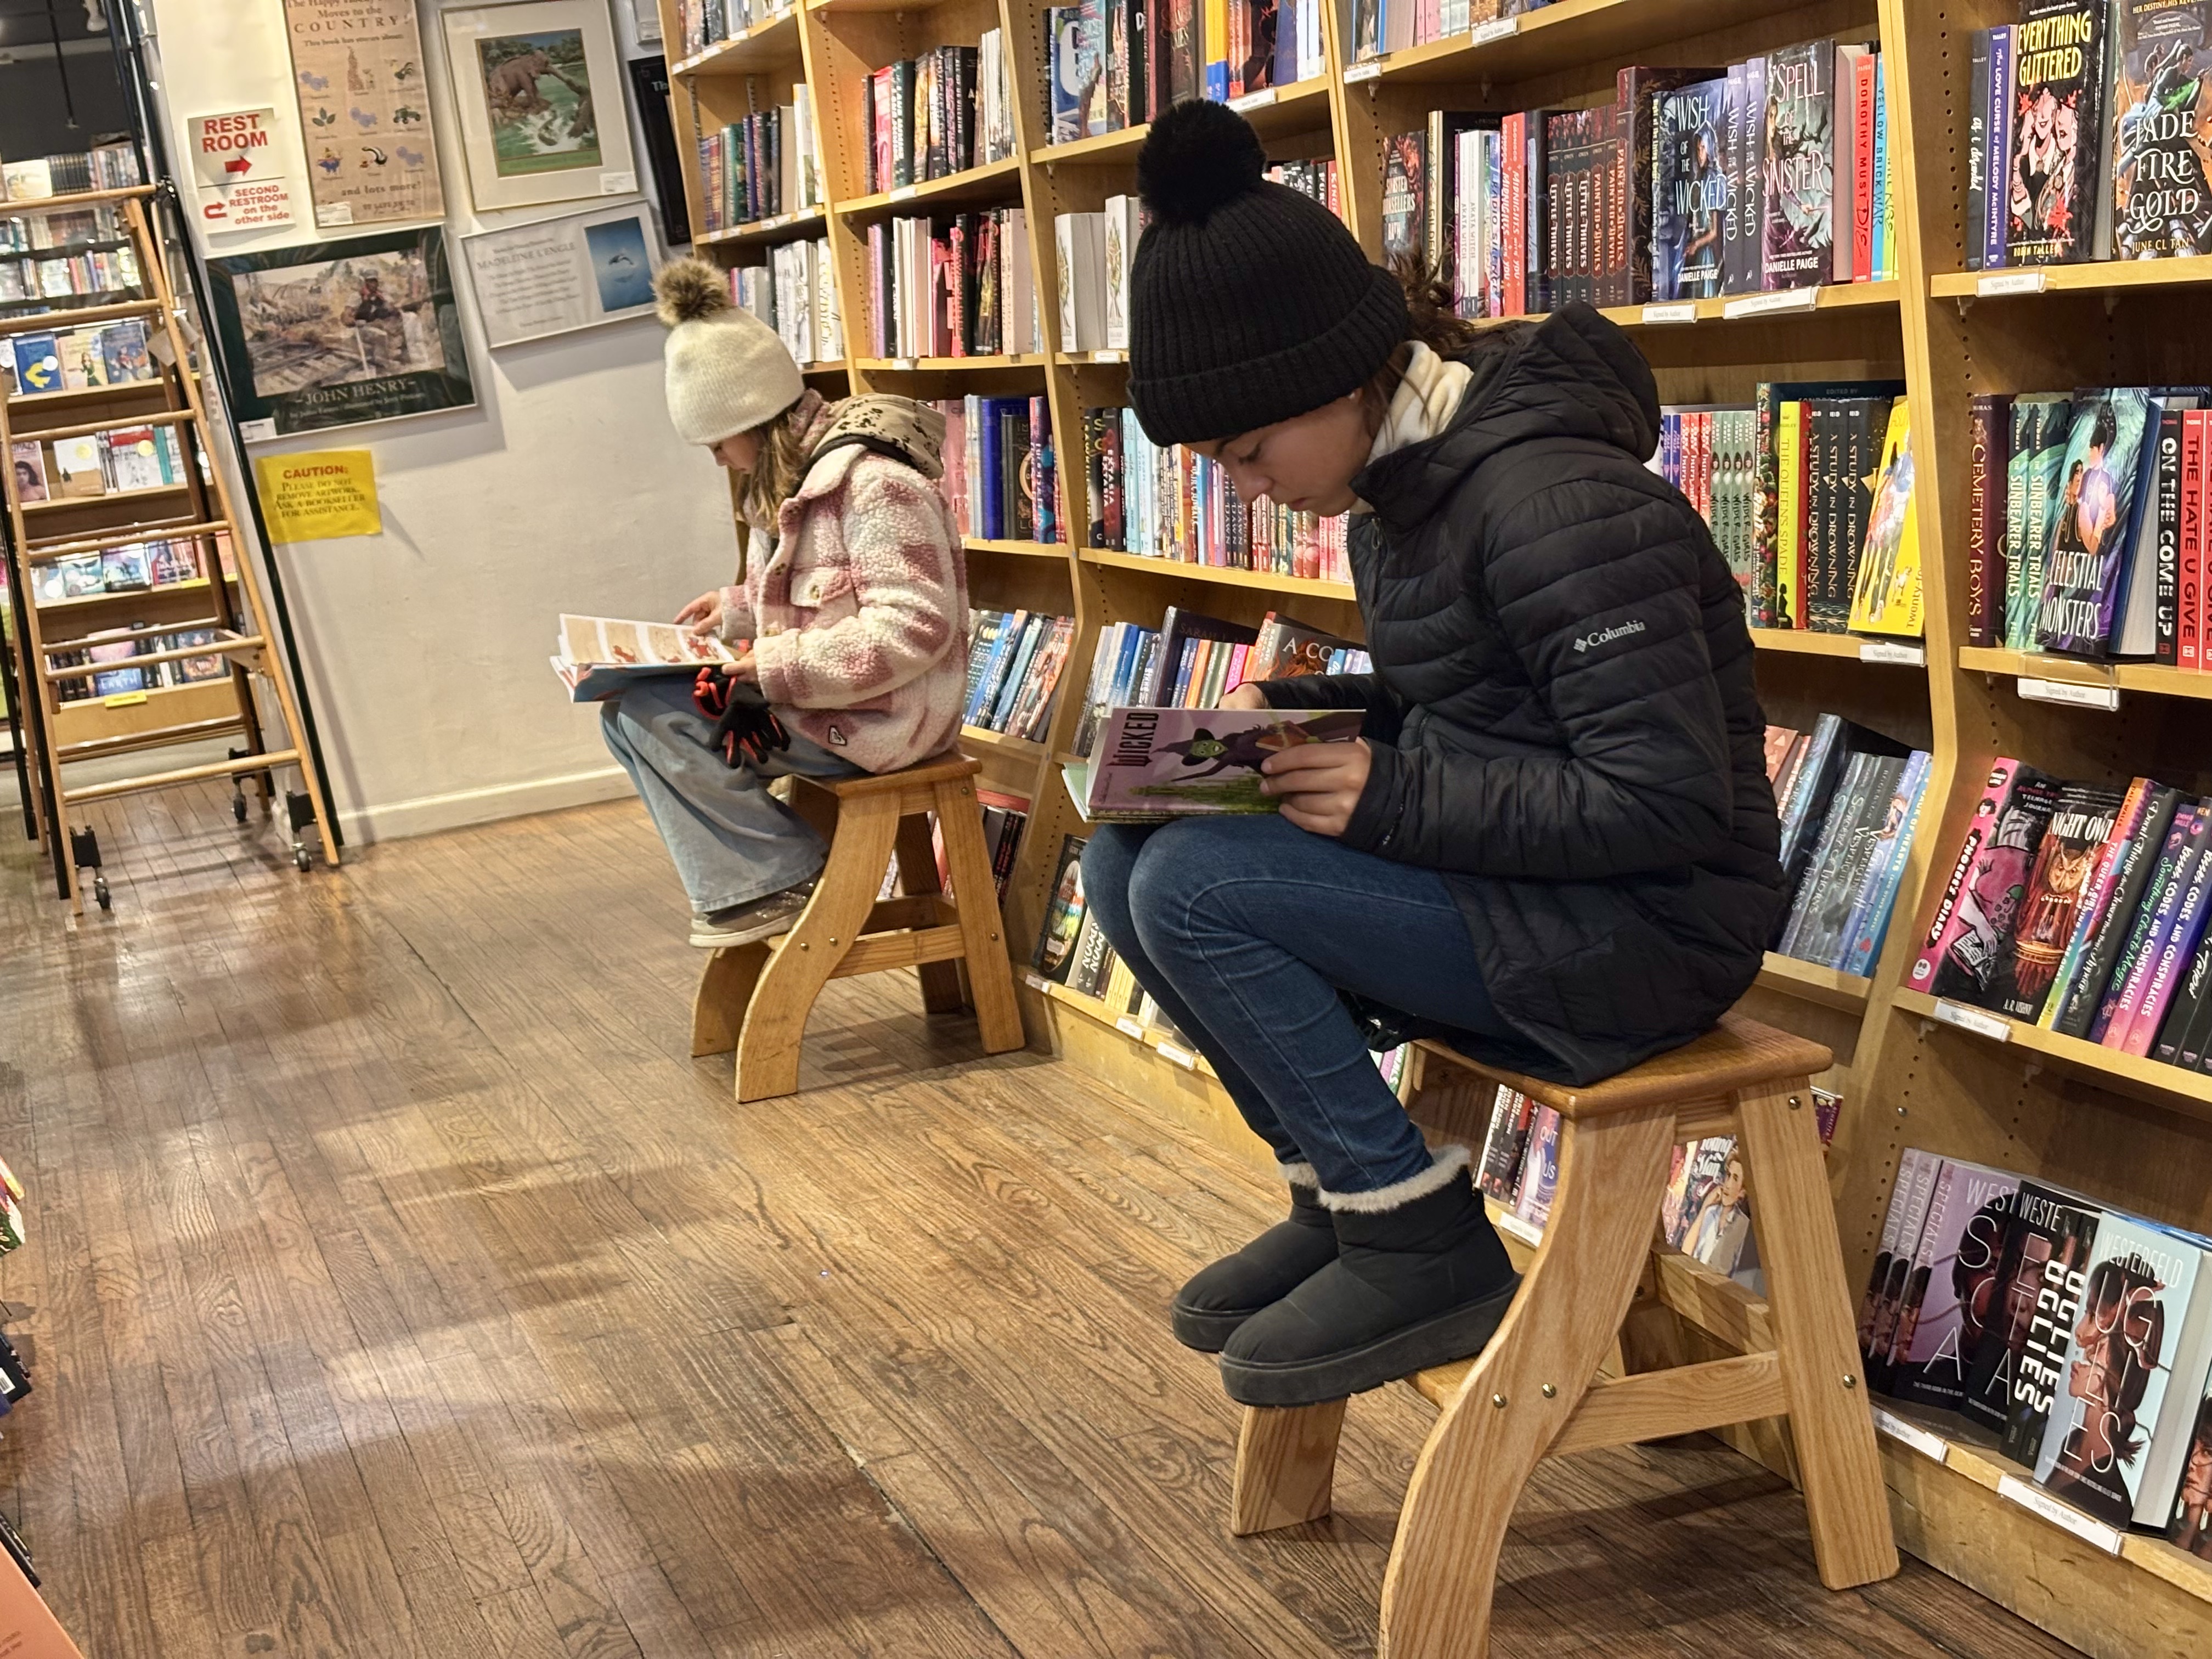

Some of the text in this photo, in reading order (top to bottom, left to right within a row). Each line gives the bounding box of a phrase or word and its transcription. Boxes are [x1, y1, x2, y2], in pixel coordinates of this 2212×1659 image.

[2133, 6, 2142, 14] HER
[2017, 10, 2092, 55] EVERYTHING
[1776, 60, 1825, 103] SPELL
[2019, 47, 2083, 87] GLITTERED
[204, 114, 259, 134] REST
[1677, 94, 1711, 132] WISH
[1785, 110, 1794, 126] OF
[1877, 88, 1886, 140] YELLOW
[2131, 110, 2198, 152] JADE
[202, 131, 268, 153] ROOM
[1680, 140, 1688, 155] OF
[1783, 133, 1795, 146] THE
[1858, 78, 1868, 201] DOROTHY MUST
[1681, 158, 1690, 173] THE
[1725, 107, 1740, 241] WISH WICKED
[1745, 101, 1757, 236] WISH WICKED
[1762, 149, 1832, 198] SINISTER
[2134, 148, 2195, 184] FIRE
[229, 193, 289, 207] RESTROOM
[235, 185, 279, 197] SECOND
[244, 206, 257, 215] on
[341, 187, 360, 196] and
[365, 185, 386, 194] lots
[1512, 171, 1520, 235] MIDNIGHTS
[1550, 184, 1558, 221] LITTLE
[1675, 173, 1726, 218] WICKED
[1873, 192, 1884, 228] WAR
[2127, 188, 2199, 234] GOLD
[235, 211, 289, 224] other side
[1565, 182, 1573, 269] LITTLE THIEVES
[1578, 180, 1589, 268] LITTLE THIEVES
[1617, 212, 1626, 262] DEVILS
[1990, 193, 1999, 245] McINTYRE
[1491, 228, 1499, 293] SILENCE
[1593, 230, 1603, 272] DEVILS
[1765, 257, 1819, 274] DANIELLE PAIGE
[2013, 246, 2030, 257] ROBIN
[2132, 237, 2189, 255] JUNE CL TAN
[1677, 268, 1718, 283] DANIELLE PAIGE
[1780, 439, 1790, 466] THE
[1812, 445, 1820, 493] STUDY
[1829, 445, 1838, 493] STUDY
[1848, 445, 1858, 493] STUDY
[2161, 437, 2177, 471] ON
[2186, 435, 2199, 481] THE
[1107, 449, 1115, 504] EXTASIA
[1732, 494, 1741, 533] WILDER
[1742, 493, 1751, 533] WILDER
[1811, 495, 1819, 507] IN
[1830, 496, 1836, 508] IN
[1848, 496, 1855, 509] IN
[2160, 478, 2176, 522] THE
[2185, 490, 2198, 551] HATE
[1970, 444, 1987, 616] CEMETERY BOYS
[2008, 475, 2023, 597] SUNBEARER TRIALS
[2029, 475, 2044, 598] SUNBEARER TRIALS
[1779, 529, 1788, 575] SPADE
[1810, 512, 1820, 595] DROWNING
[1828, 513, 1838, 597] DROWNING
[2049, 549, 2104, 591] CELESTIAL
[2159, 529, 2175, 597] COME
[2184, 558, 2196, 574] U
[2039, 591, 2102, 641] MONSTERS
[2158, 605, 2174, 636] UP
[2183, 582, 2196, 638] GIVE
[1282, 637, 1297, 655] A
[1587, 620, 1646, 646] Columbia
[1105, 712, 1159, 767] WICKED
[2022, 794, 2052, 805] TEENAGE
[2138, 800, 2160, 838] Dead
[2052, 811, 2114, 844] NIGHT OWL
[1809, 795, 1864, 913] SORCERY THORNS
[1892, 833, 1912, 872] HEARTS
[2094, 842, 2118, 894] THE QUEER
[1931, 835, 1978, 940] PHOEBE'S DIARY
[2111, 856, 2174, 992] Something Close Magic
[2119, 881, 2179, 1011] CODES, AND CONSPIRACIES
[2141, 885, 2200, 1017] CODES, AND CONSPIRACIES
[2188, 950, 2210, 1000] Taipei
[1539, 1126, 1559, 1146] OUT
[1543, 1161, 1556, 1180] US
[1883, 1167, 1911, 1243] SPECIALS
[1899, 1174, 1930, 1250] SPECIALS
[1922, 1181, 1951, 1258] SPECIALS
[2098, 1232, 2184, 1288] WESTERFELD
[2014, 1259, 2068, 1404] UGLIES
[2059, 1510, 2078, 1526] Author
